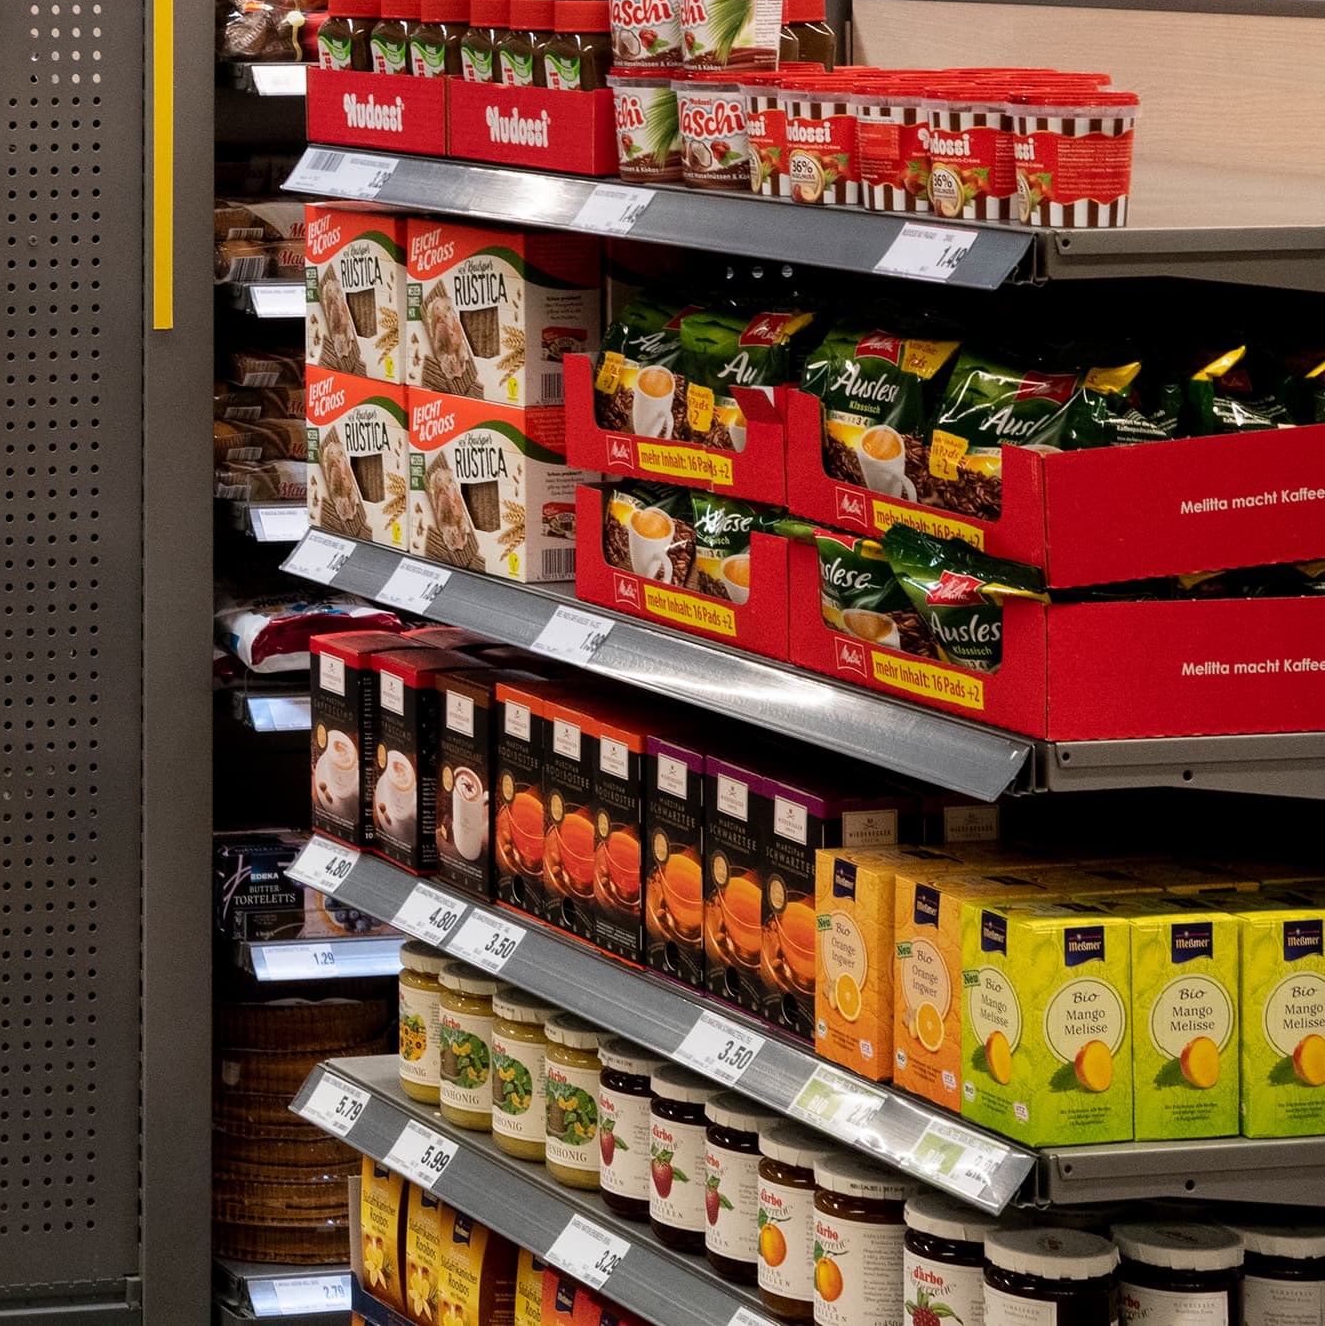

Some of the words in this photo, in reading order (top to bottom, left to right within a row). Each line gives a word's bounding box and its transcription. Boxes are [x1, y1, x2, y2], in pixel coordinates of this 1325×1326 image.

[343, 92, 404, 134] Nudossi
[485, 105, 550, 149] Nudossi
[791, 159, 813, 174] 36%
[933, 173, 953, 188] 36%
[308, 214, 332, 246] LEICHT
[312, 226, 342, 256] &CROSS
[410, 228, 443, 262] LEICHT
[417, 241, 455, 272] &CROSS
[340, 256, 385, 289] RUSTICA
[453, 273, 509, 307] RUSTICA
[309, 376, 334, 408] LEICHT
[314, 389, 346, 418] &CROSS
[849, 399, 881, 415] Klassisch
[412, 399, 443, 432] LEICHT
[344, 422, 391, 452] RUSTICA
[419, 412, 456, 442] &CROSS
[454, 447, 509, 479] RUSTICA
[641, 450, 661, 465] mehr
[661, 451, 687, 470] Inhalt:
[688, 456, 697, 470] 16
[718, 463, 730, 479] +2
[935, 458, 949, 475] +2
[1180, 496, 1228, 515] Melitta
[1231, 490, 1278, 510] macht
[1280, 486, 1325, 504] Kaffee
[876, 509, 900, 526] mehr
[932, 524, 943, 538] 16
[968, 532, 981, 549] +2
[647, 592, 667, 611] mehr
[668, 597, 692, 619] Inhalt:
[693, 603, 703, 622] 16
[702, 608, 721, 627] Pads
[722, 615, 733, 631] +2
[930, 611, 1001, 644] Ausles
[952, 645, 993, 657] Klassisch
[1181, 661, 1231, 677] Melitta
[1234, 658, 1281, 674] macht
[875, 659, 899, 679] mehr
[900, 663, 931, 689] Inhalt:
[931, 674, 943, 691] 16
[944, 676, 966, 698] Pads
[967, 684, 981, 703] +2
[650, 800, 696, 829] SCHWARZTEE
[709, 823, 758, 851] SCHWARZTEE
[325, 856, 352, 880] 4.80
[765, 846, 816, 876] SCHWARZTEE
[233, 893, 296, 906] TORTELETTS
[428, 906, 458, 932] 4.80
[817, 916, 832, 931] Neu
[835, 922, 851, 937] Bio
[485, 933, 517, 959] 3.50
[831, 937, 857, 957] Orange
[897, 943, 913, 957] Neu
[1068, 939, 1102, 953] Meßmer
[1175, 937, 1210, 950] Meßmer
[1287, 935, 1320, 948] Meßmer
[312, 951, 336, 966] 1.29
[831, 949, 855, 971] Ingwer
[916, 949, 933, 965] Bio
[911, 964, 939, 986] Orange
[962, 972, 981, 986] Neu
[985, 977, 1003, 993] Bio
[912, 978, 938, 1000] Ingwer
[1072, 991, 1100, 1005] Bio
[1178, 988, 1207, 1001] Bio
[1291, 986, 1319, 999] Bio
[980, 994, 1008, 1014] Mango
[1066, 1008, 1106, 1022] Mango
[1172, 1005, 1214, 1020] Mango
[1284, 1002, 1324, 1017] Mango
[979, 1008, 1009, 1029] Melisse
[1063, 1022, 1109, 1036] Melisse
[1169, 1019, 1216, 1033] Melisse
[1282, 1017, 1325, 1030] Melisse
[717, 1039, 754, 1071] 3.50
[335, 1095, 364, 1122] 5.79
[420, 1144, 450, 1172] 5.99
[369, 1207, 389, 1229] Rooibos
[415, 1235, 437, 1261] Rooibos
[323, 1284, 345, 1300] 2.79
[448, 1275, 471, 1298] Rooibos
